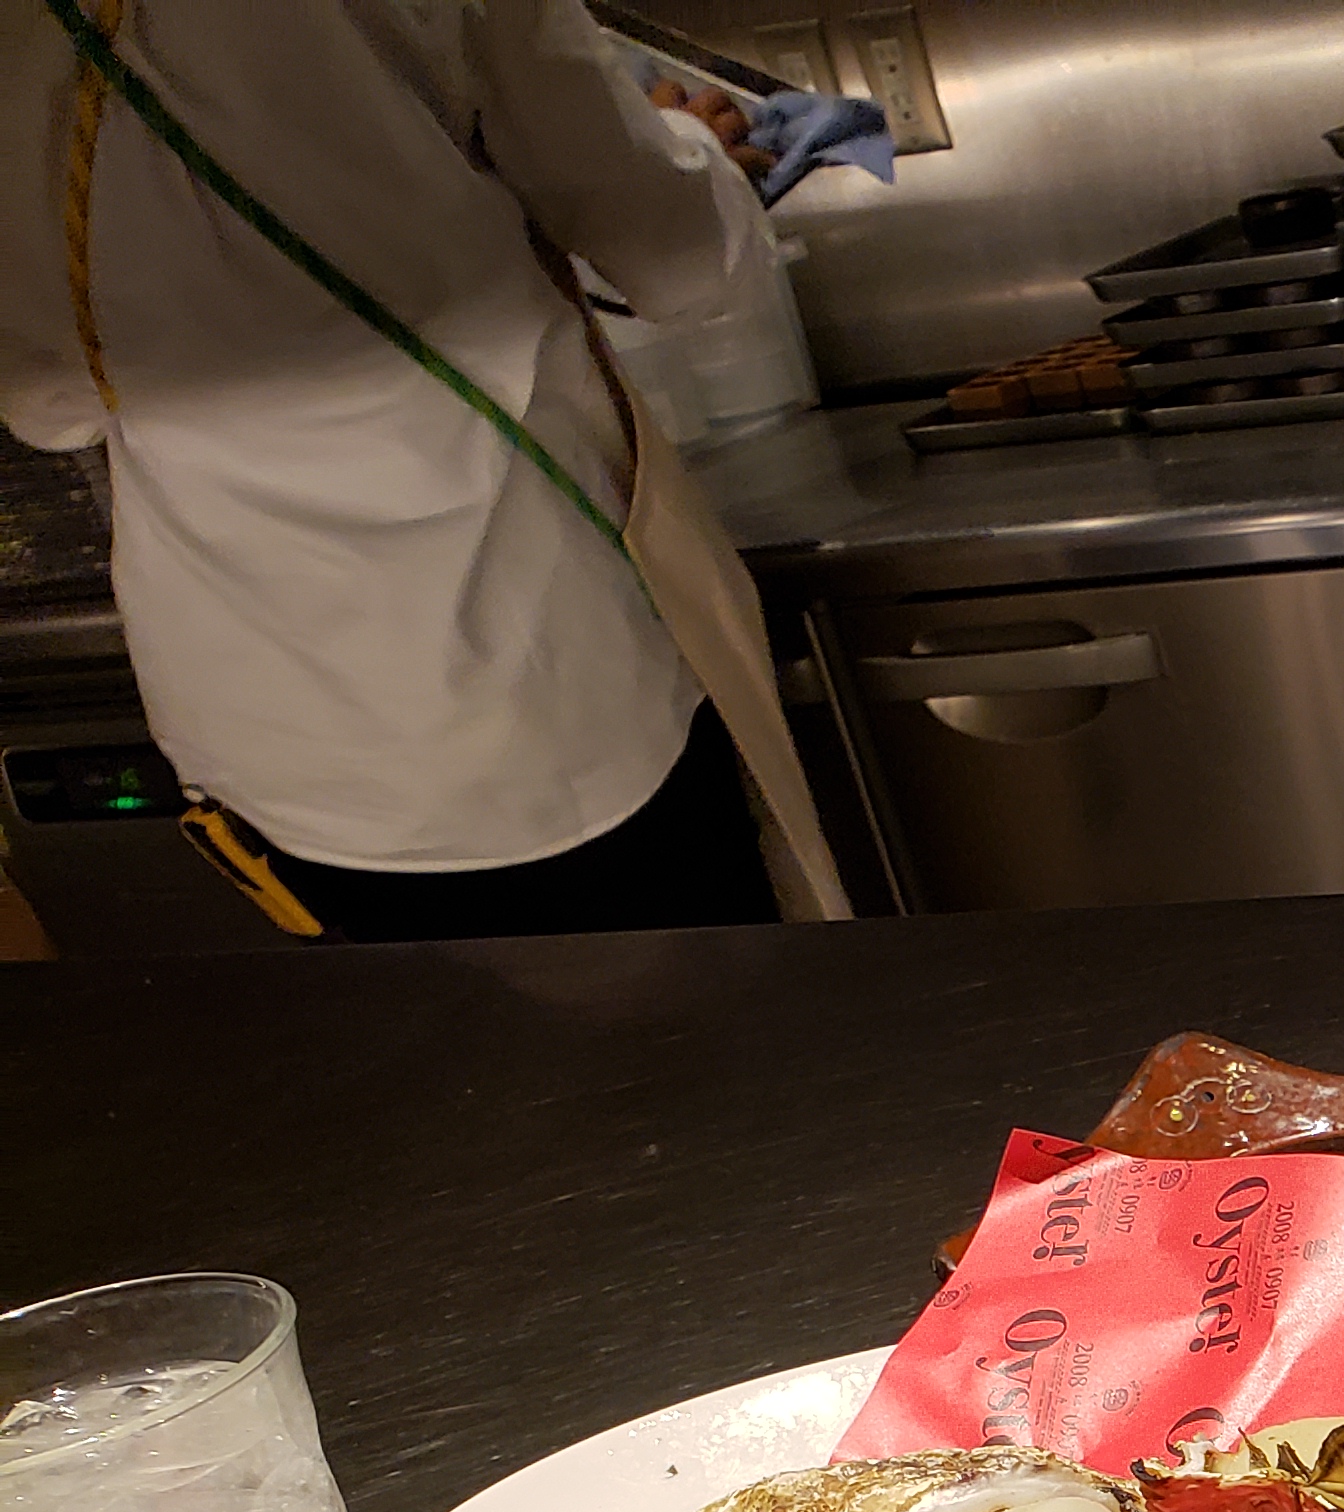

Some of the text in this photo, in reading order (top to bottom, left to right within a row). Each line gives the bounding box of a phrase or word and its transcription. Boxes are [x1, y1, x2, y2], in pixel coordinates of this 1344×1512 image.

[1114, 1195, 1140, 1234] 0907
[1272, 1201, 1295, 1244] 2008
[1189, 1176, 1270, 1355] Oyster
[1261, 1267, 1284, 1311] 0907
[1068, 1342, 1094, 1387] 2008
